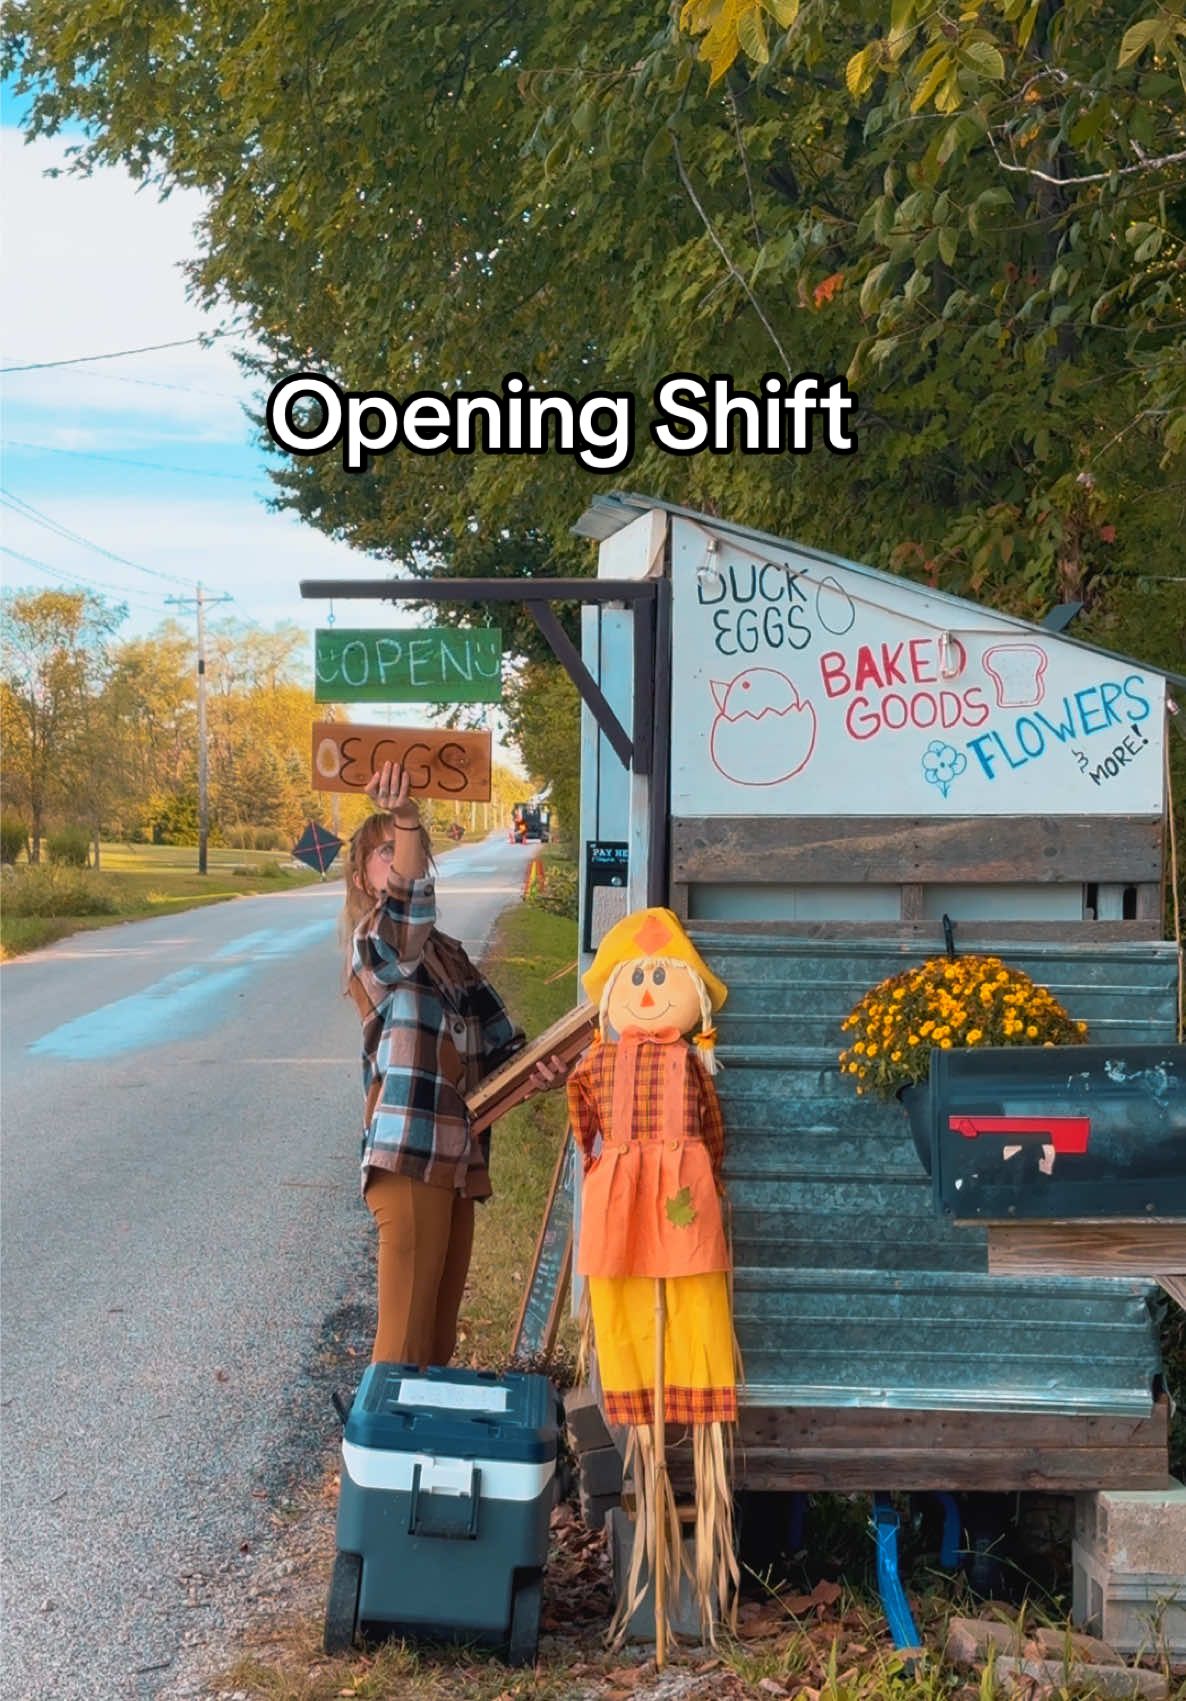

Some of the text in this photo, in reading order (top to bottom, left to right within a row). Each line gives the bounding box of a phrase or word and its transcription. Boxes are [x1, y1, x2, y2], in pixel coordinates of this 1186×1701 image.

[697, 562, 808, 605] DUCK
[713, 605, 811, 655] EGGS
[341, 638, 473, 686] OPEN
[820, 638, 967, 698] BAKED
[846, 687, 989, 740] GOODS
[966, 675, 1150, 780] FLOWERS
[1089, 723, 1149, 786] MORE!
[593, 848, 612, 857] PAY
